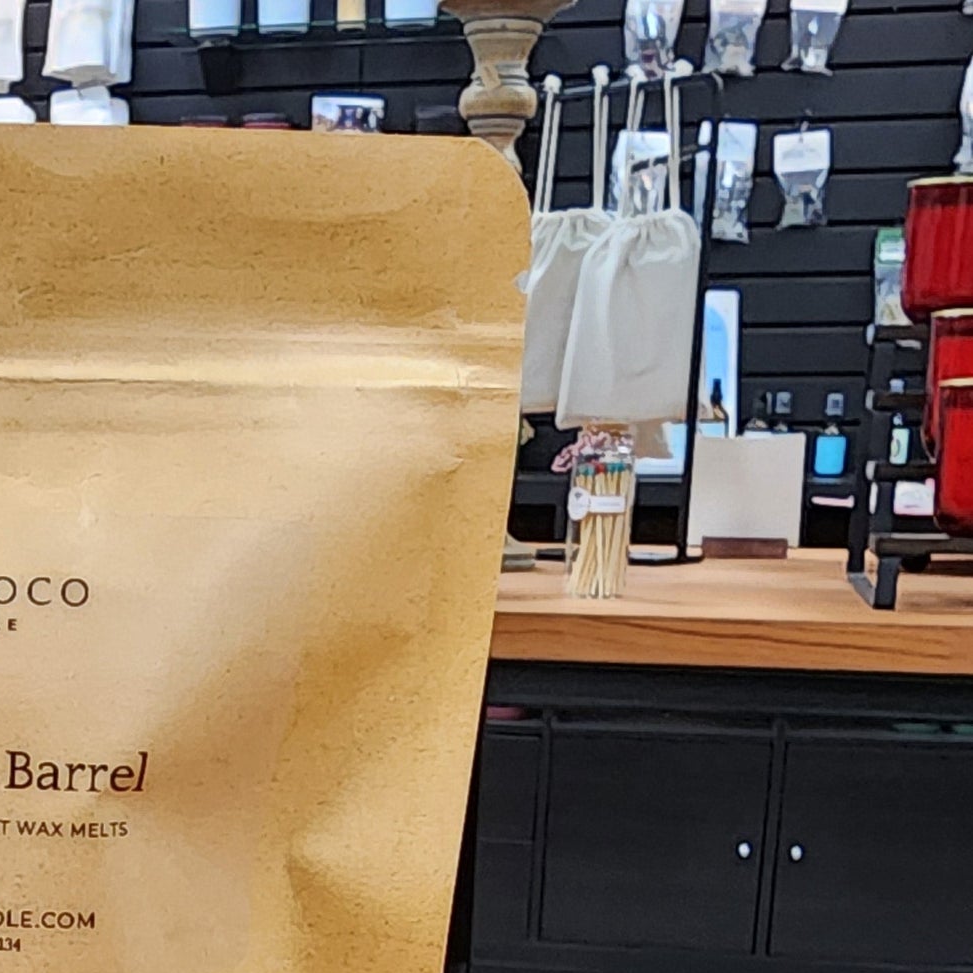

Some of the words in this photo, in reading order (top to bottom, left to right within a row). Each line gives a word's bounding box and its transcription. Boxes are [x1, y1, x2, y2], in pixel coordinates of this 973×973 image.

[4, 750, 149, 793] Barrel
[16, 820, 64, 838] WAX
[70, 821, 129, 839] MELTS
